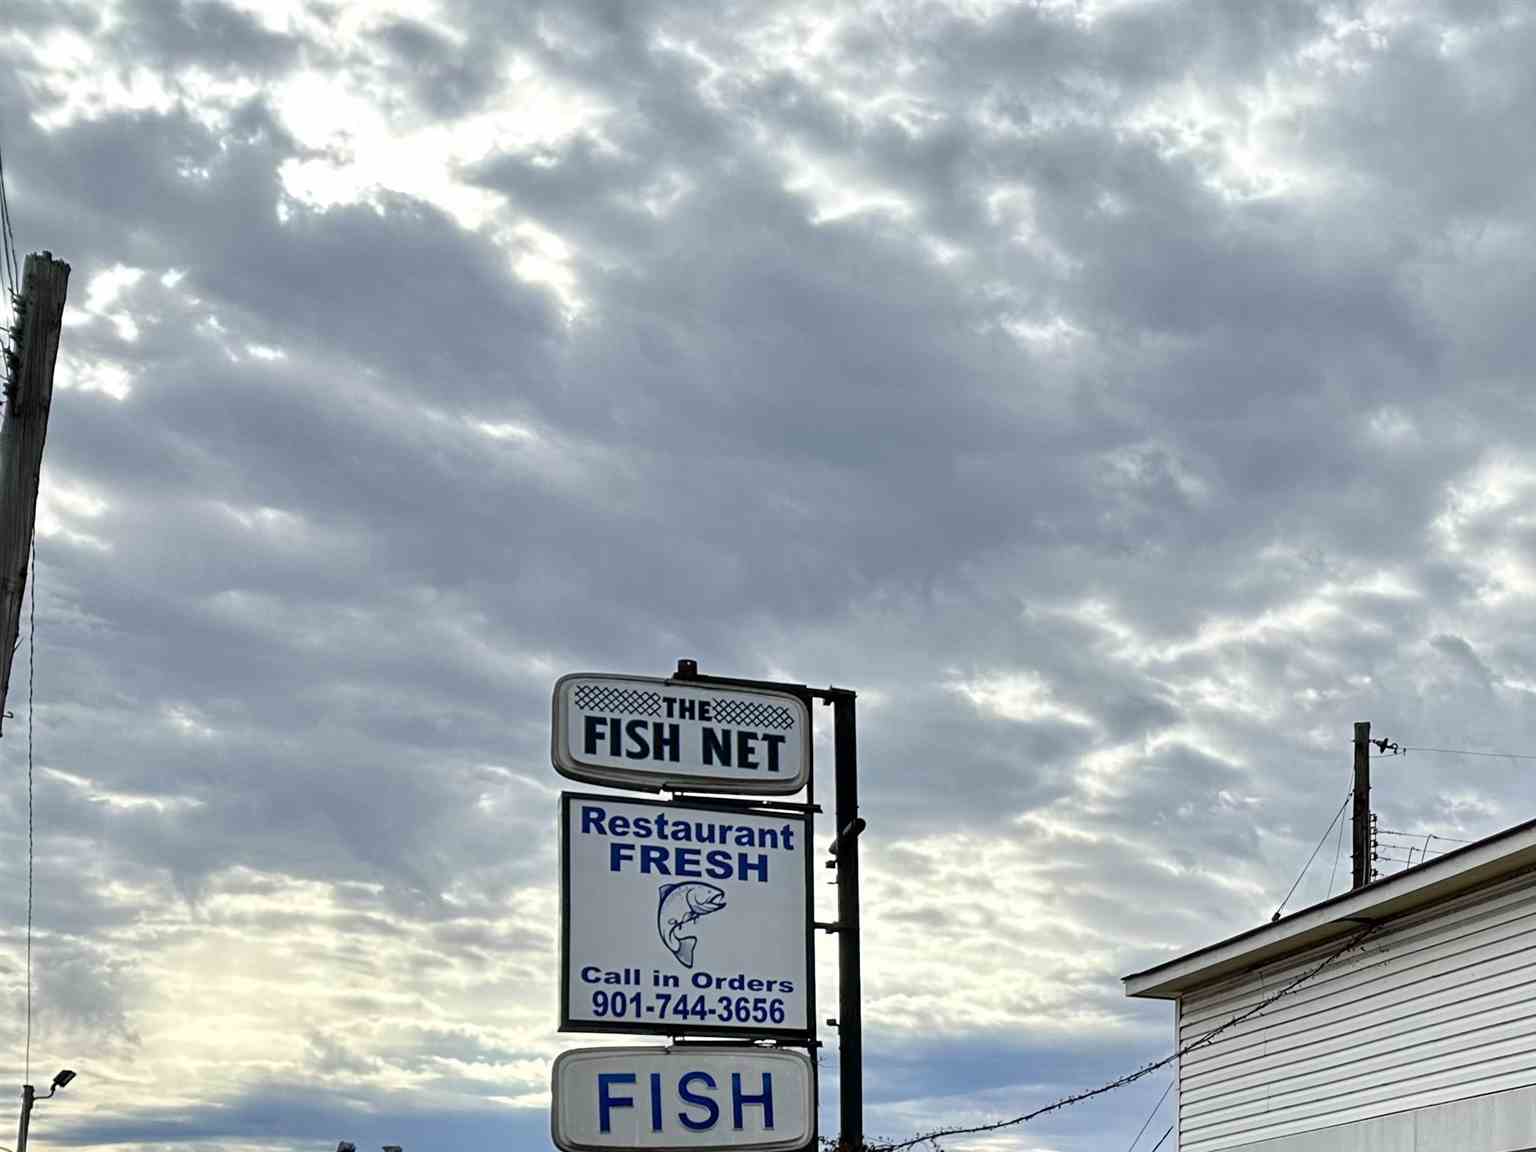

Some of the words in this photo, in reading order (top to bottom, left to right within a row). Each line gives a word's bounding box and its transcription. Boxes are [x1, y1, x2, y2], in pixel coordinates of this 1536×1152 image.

[663, 697, 714, 721] THE
[584, 715, 680, 762] FISH
[702, 726, 785, 772] NET
[581, 805, 794, 850] Restaurant
[610, 842, 768, 882] FRESH
[581, 966, 641, 986] Call
[652, 970, 680, 987] in
[691, 972, 794, 993] Orders
[592, 990, 785, 1024] 901-744-3656
[598, 1071, 775, 1133] FISH
